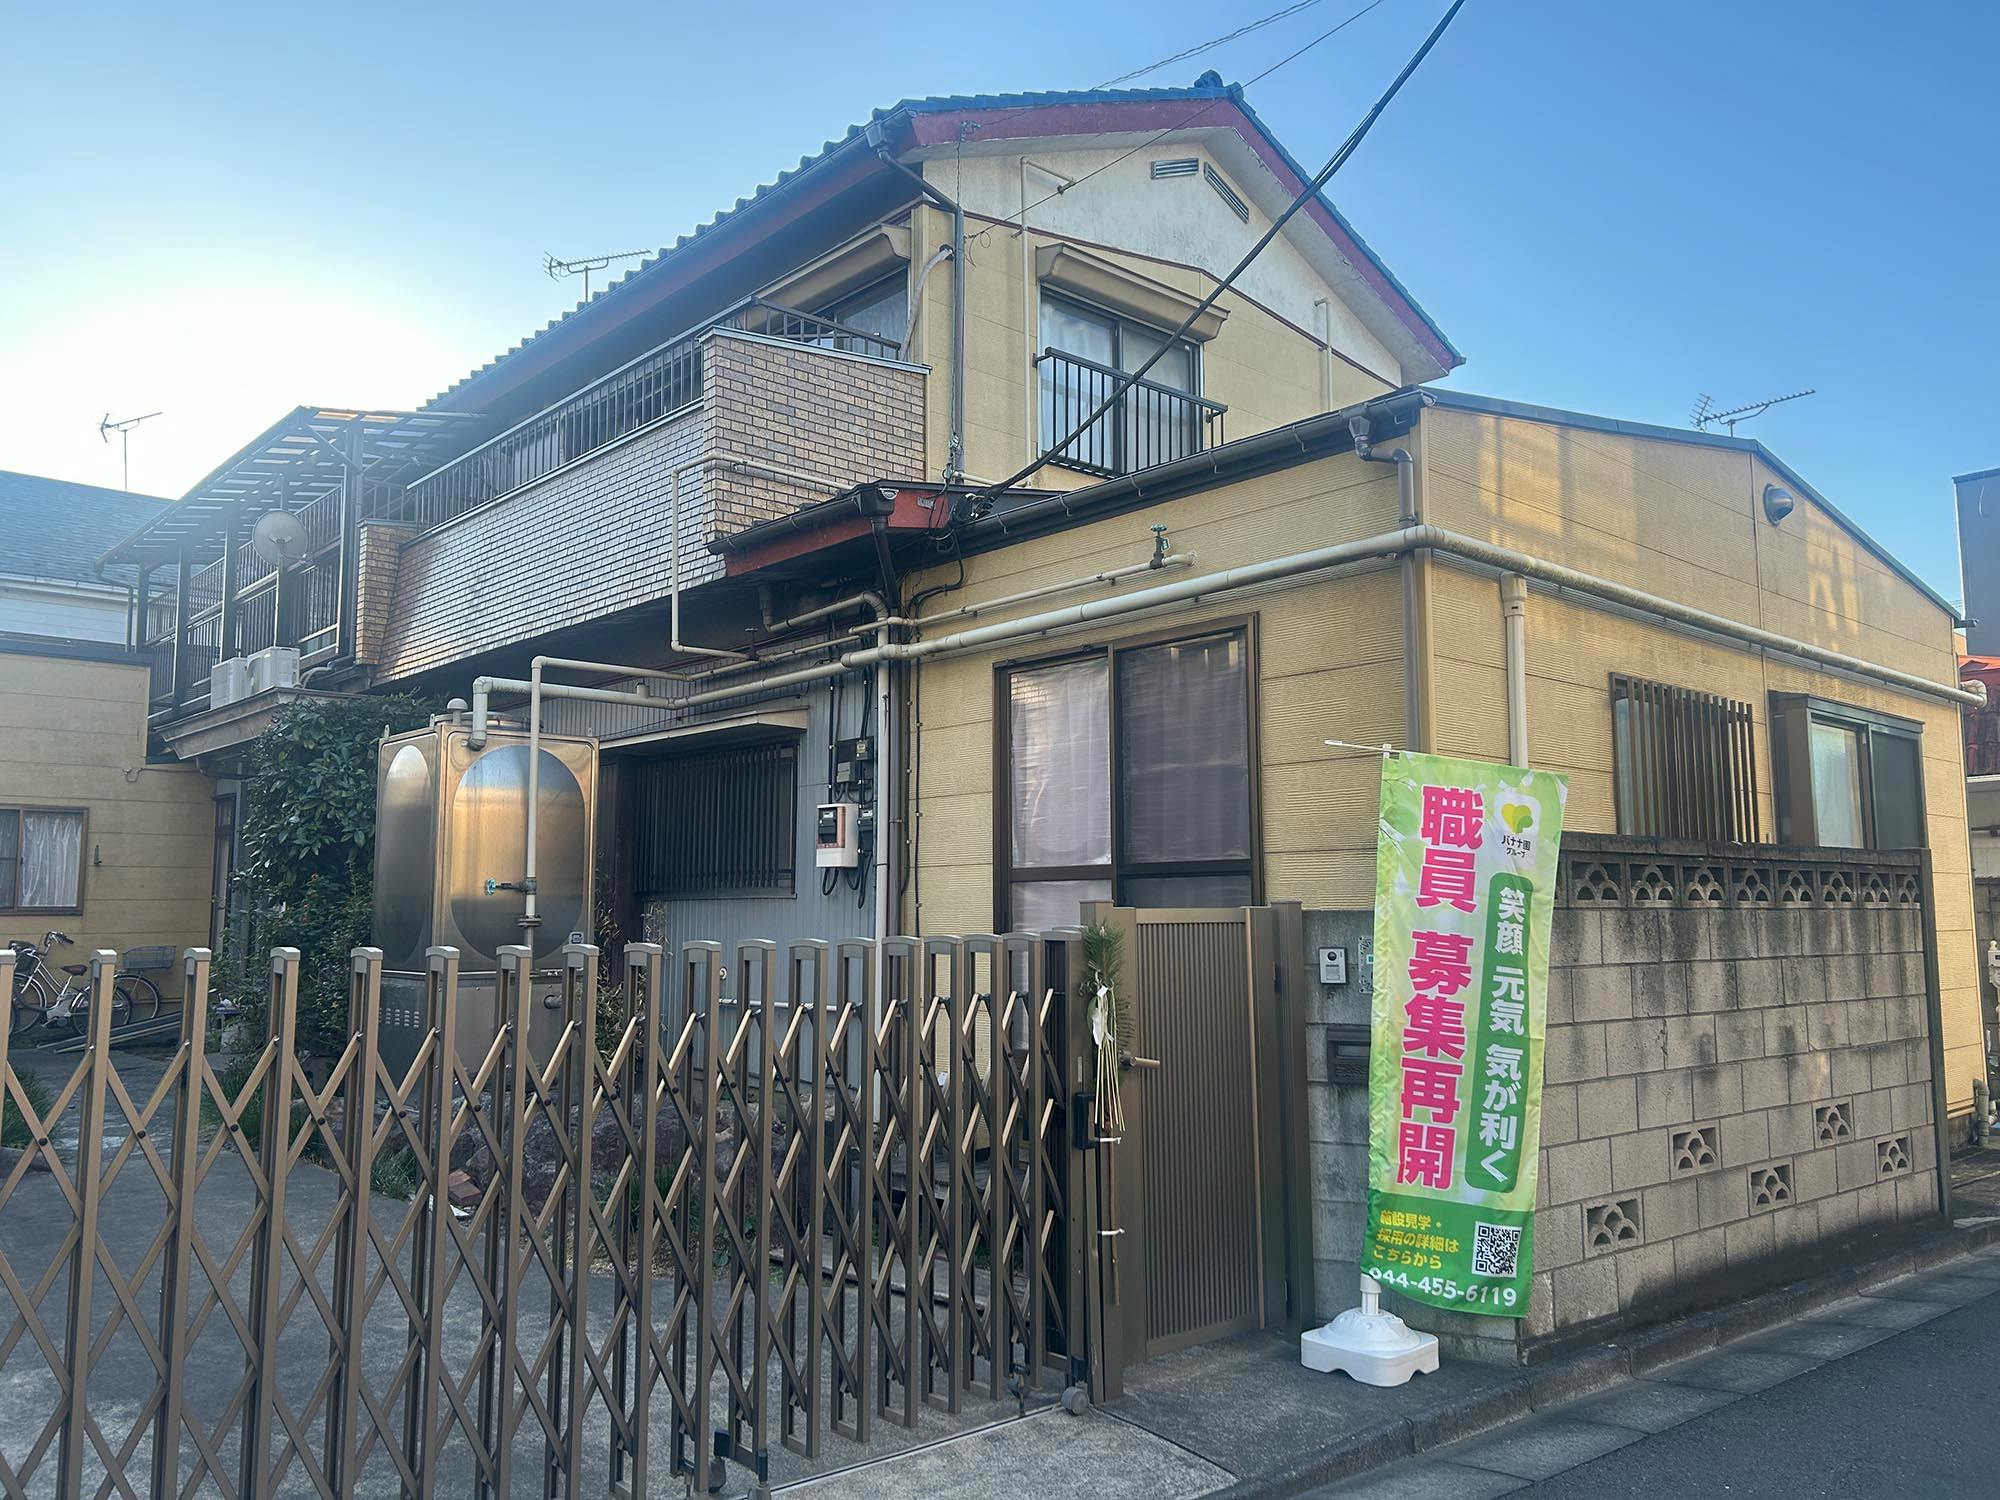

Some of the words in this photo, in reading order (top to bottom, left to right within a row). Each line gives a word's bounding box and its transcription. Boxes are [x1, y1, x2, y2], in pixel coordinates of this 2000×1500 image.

[1415, 784, 1484, 914] 職員
[1501, 834, 1531, 851] バナナ園
[1495, 886, 1526, 957] 笑顔
[1489, 964, 1526, 1036] 元気
[1396, 930, 1475, 1190] 募集再開
[1479, 1043, 1524, 1184] 気が利く
[1373, 1244, 1442, 1269] こちらから
[1375, 1227, 1460, 1253] 採用の詳細は
[1368, 1267, 1518, 1307] 044-455-6119
